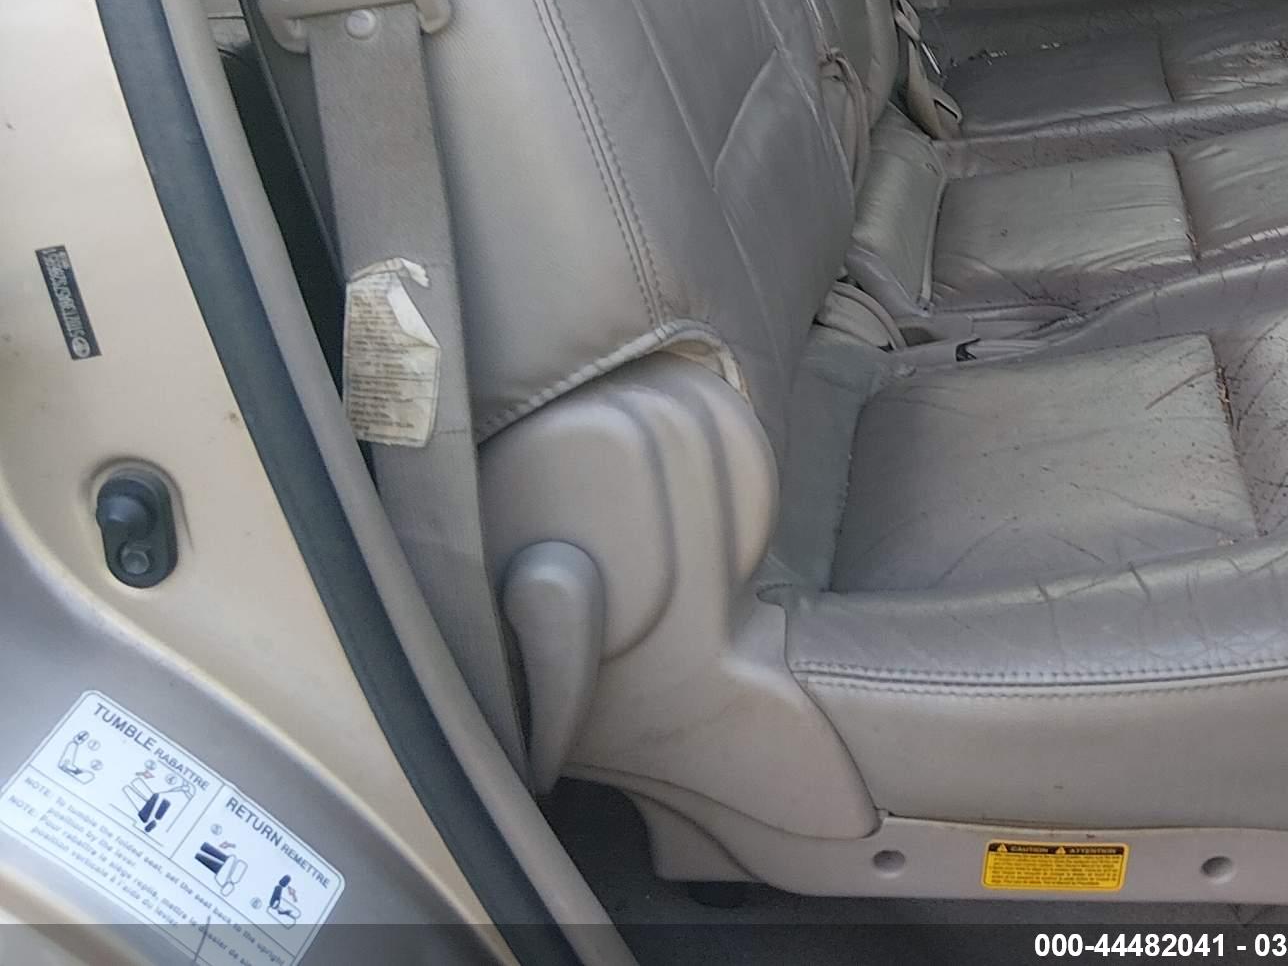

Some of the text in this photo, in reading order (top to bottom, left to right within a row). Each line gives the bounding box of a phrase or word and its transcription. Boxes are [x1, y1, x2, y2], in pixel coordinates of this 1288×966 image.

[93, 704, 209, 790] TUMBLE RABATTRE
[226, 797, 330, 888] RETURN REMETTRE
